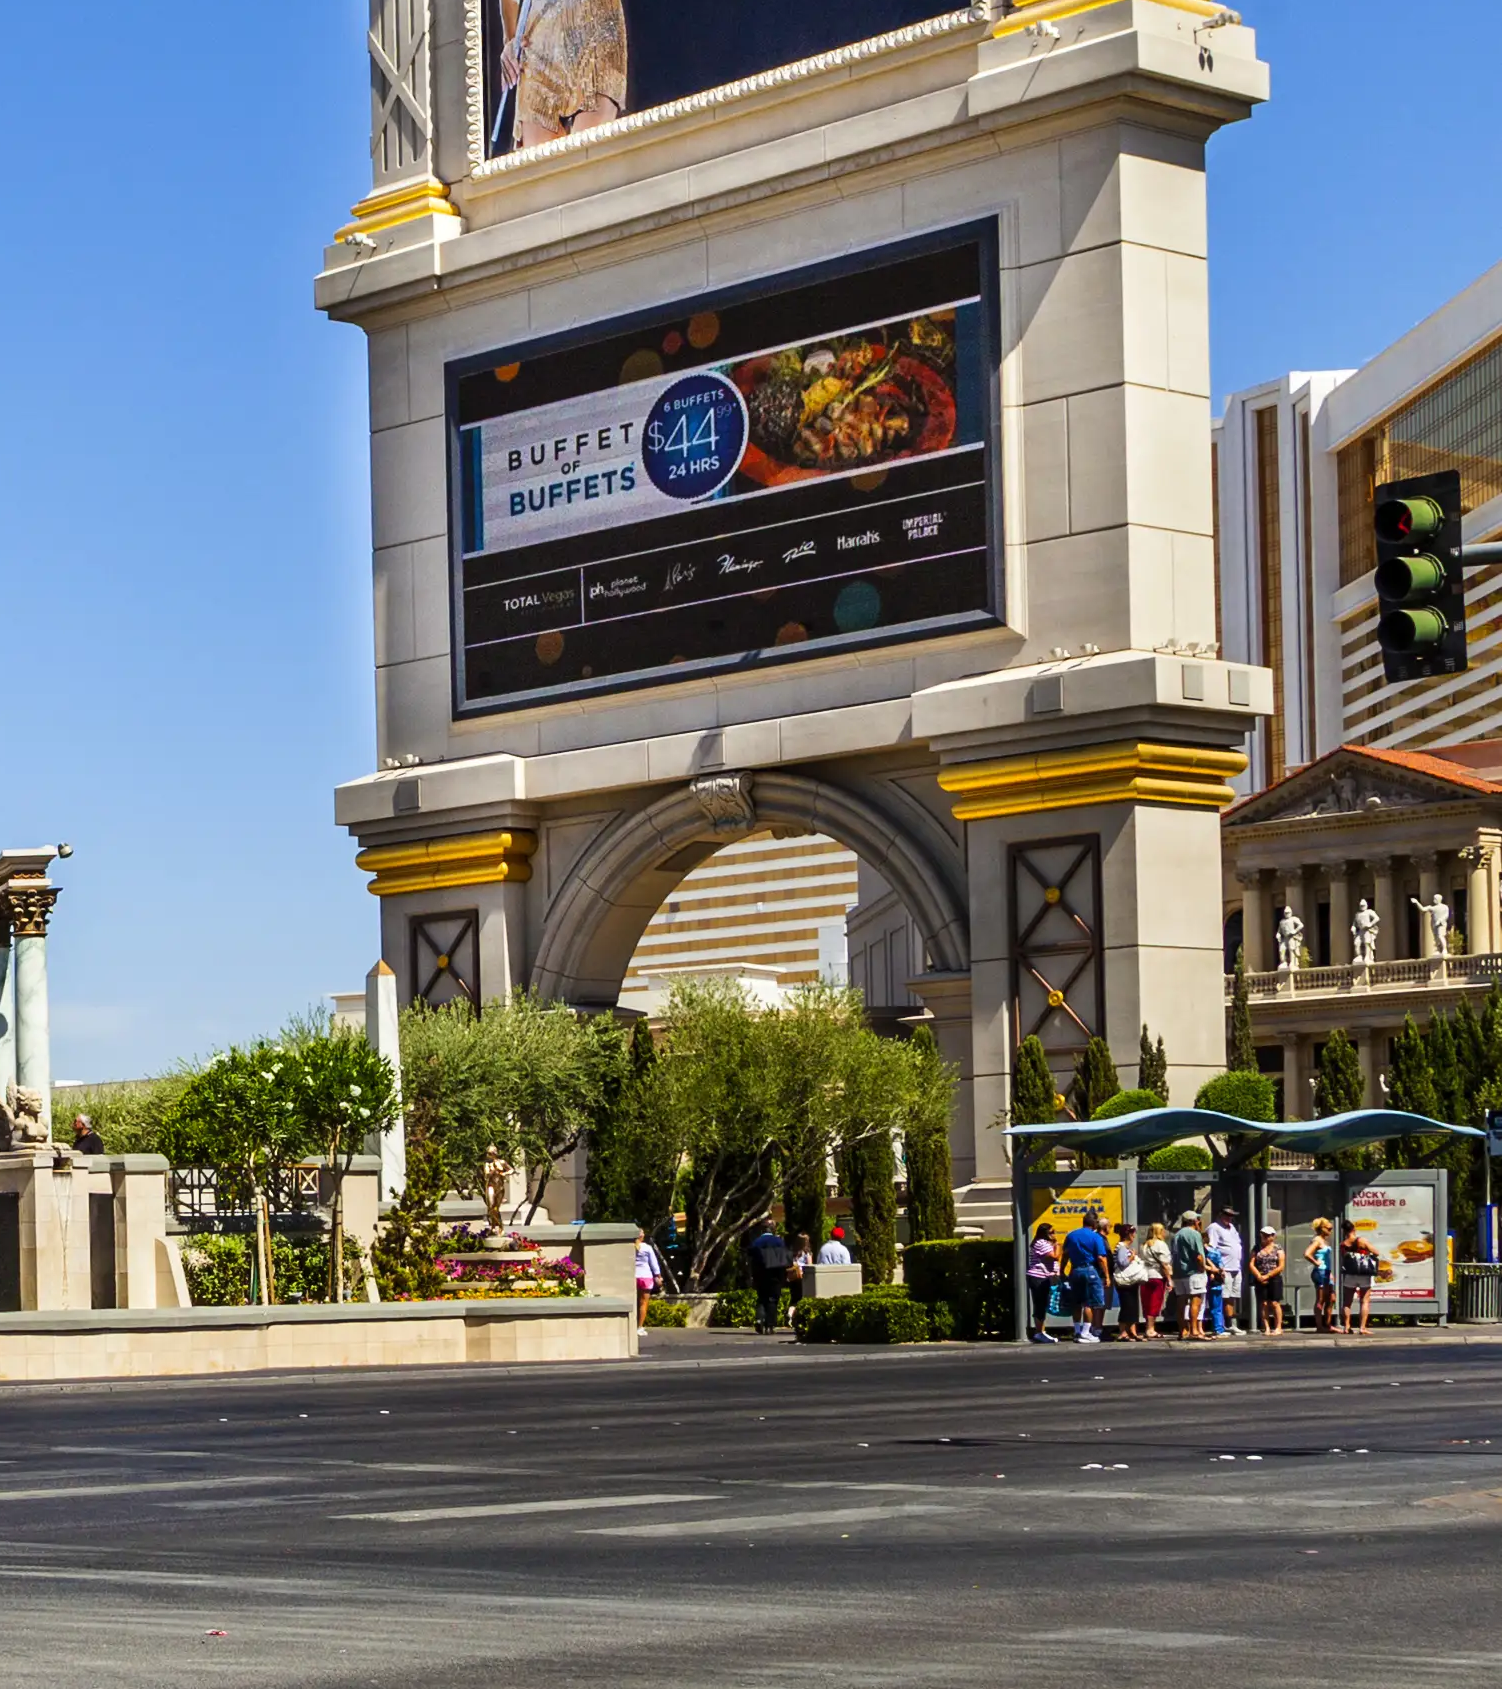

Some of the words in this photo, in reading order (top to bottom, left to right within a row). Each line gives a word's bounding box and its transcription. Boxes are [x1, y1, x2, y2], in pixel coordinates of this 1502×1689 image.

[674, 389, 725, 410] BUFFETS
[508, 422, 634, 471] BUFFET
[561, 460, 581, 475] OF
[668, 464, 687, 480] 24
[690, 456, 720, 475] HRS
[504, 594, 541, 611] TOTAL
[541, 588, 575, 604] Vegas
[590, 582, 604, 598] ph
[1352, 1199, 1396, 1207] NUMBER
